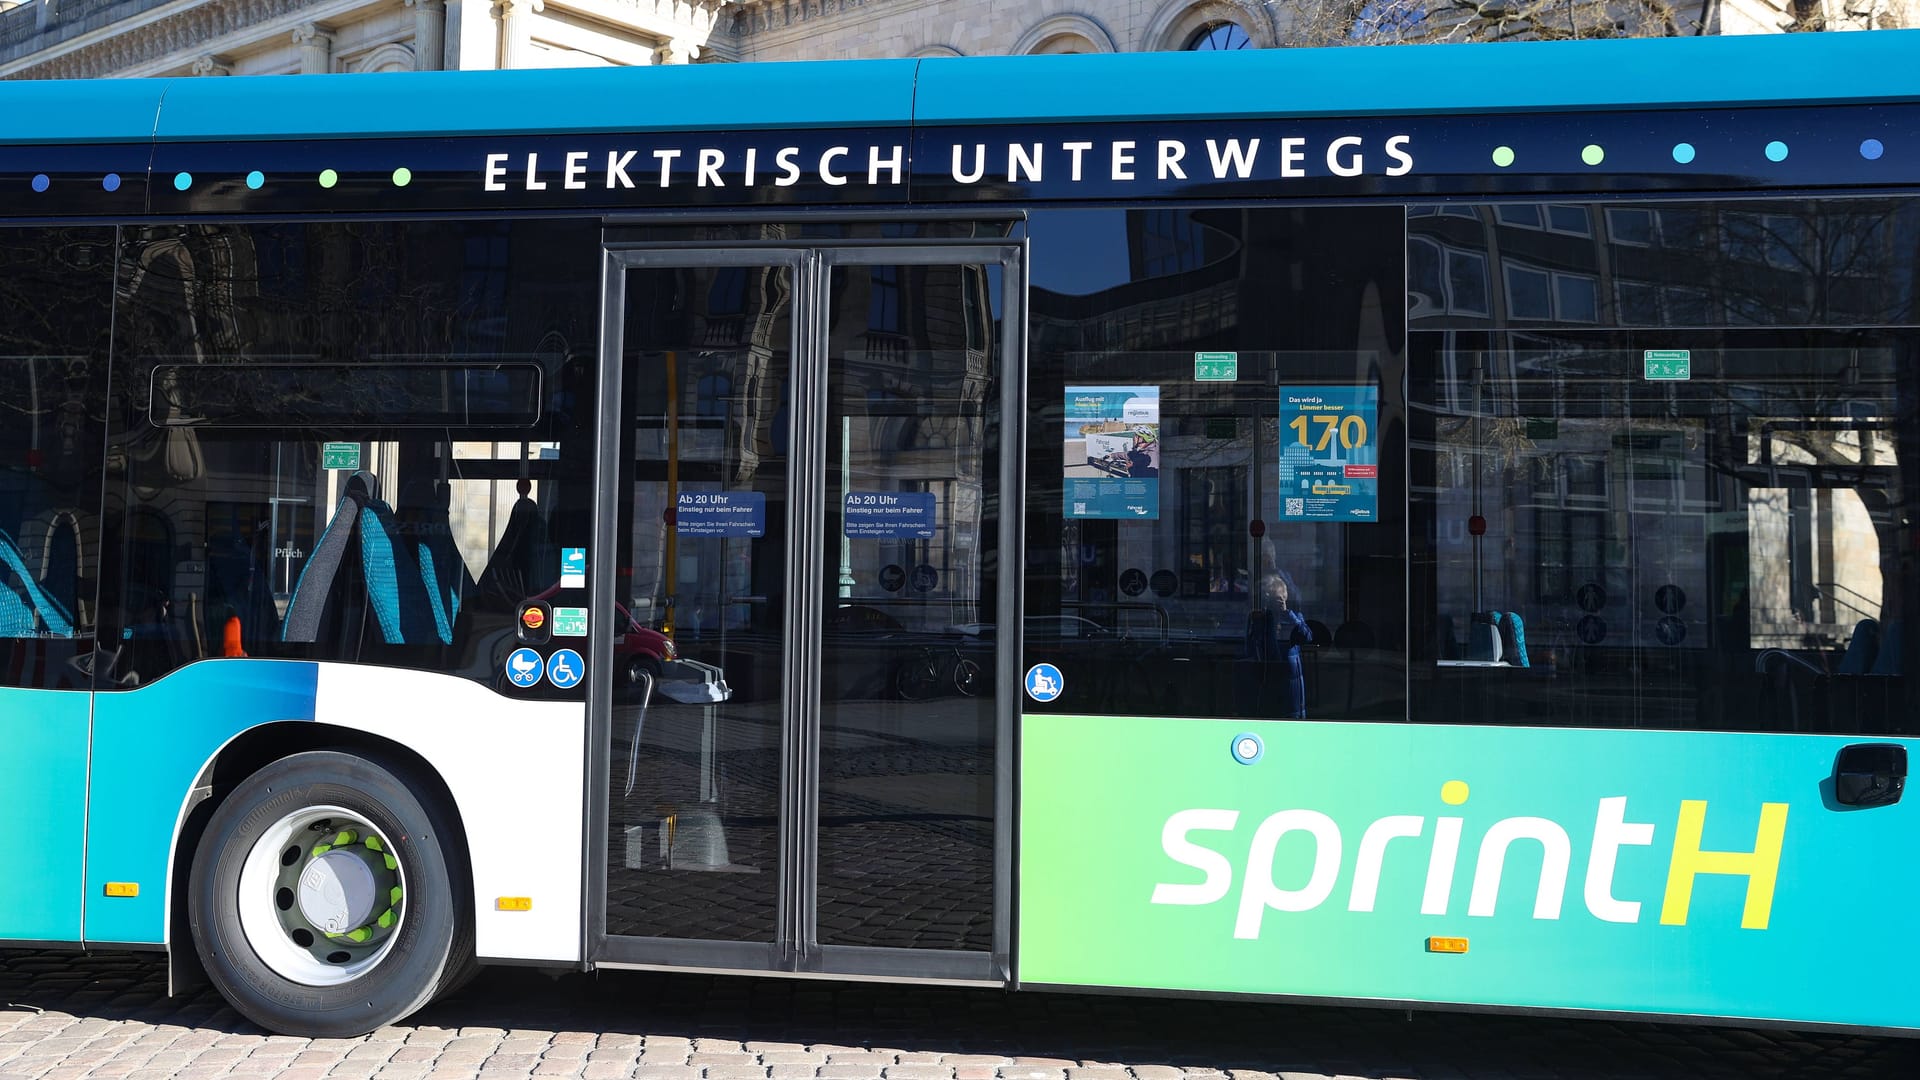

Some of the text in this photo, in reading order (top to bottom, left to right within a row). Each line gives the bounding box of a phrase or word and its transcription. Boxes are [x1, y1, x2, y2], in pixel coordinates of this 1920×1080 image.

[484, 135, 1413, 192] ELEKTRISCH UNTERWEGS
[1316, 396, 1323, 404] ja
[1288, 414, 1368, 451] 170
[678, 494, 729, 504] Ab 20 Uhr
[846, 495, 898, 505] Ab 20 Uhr
[678, 506, 703, 514] Einstieg
[1150, 780, 1787, 940] sprintH
